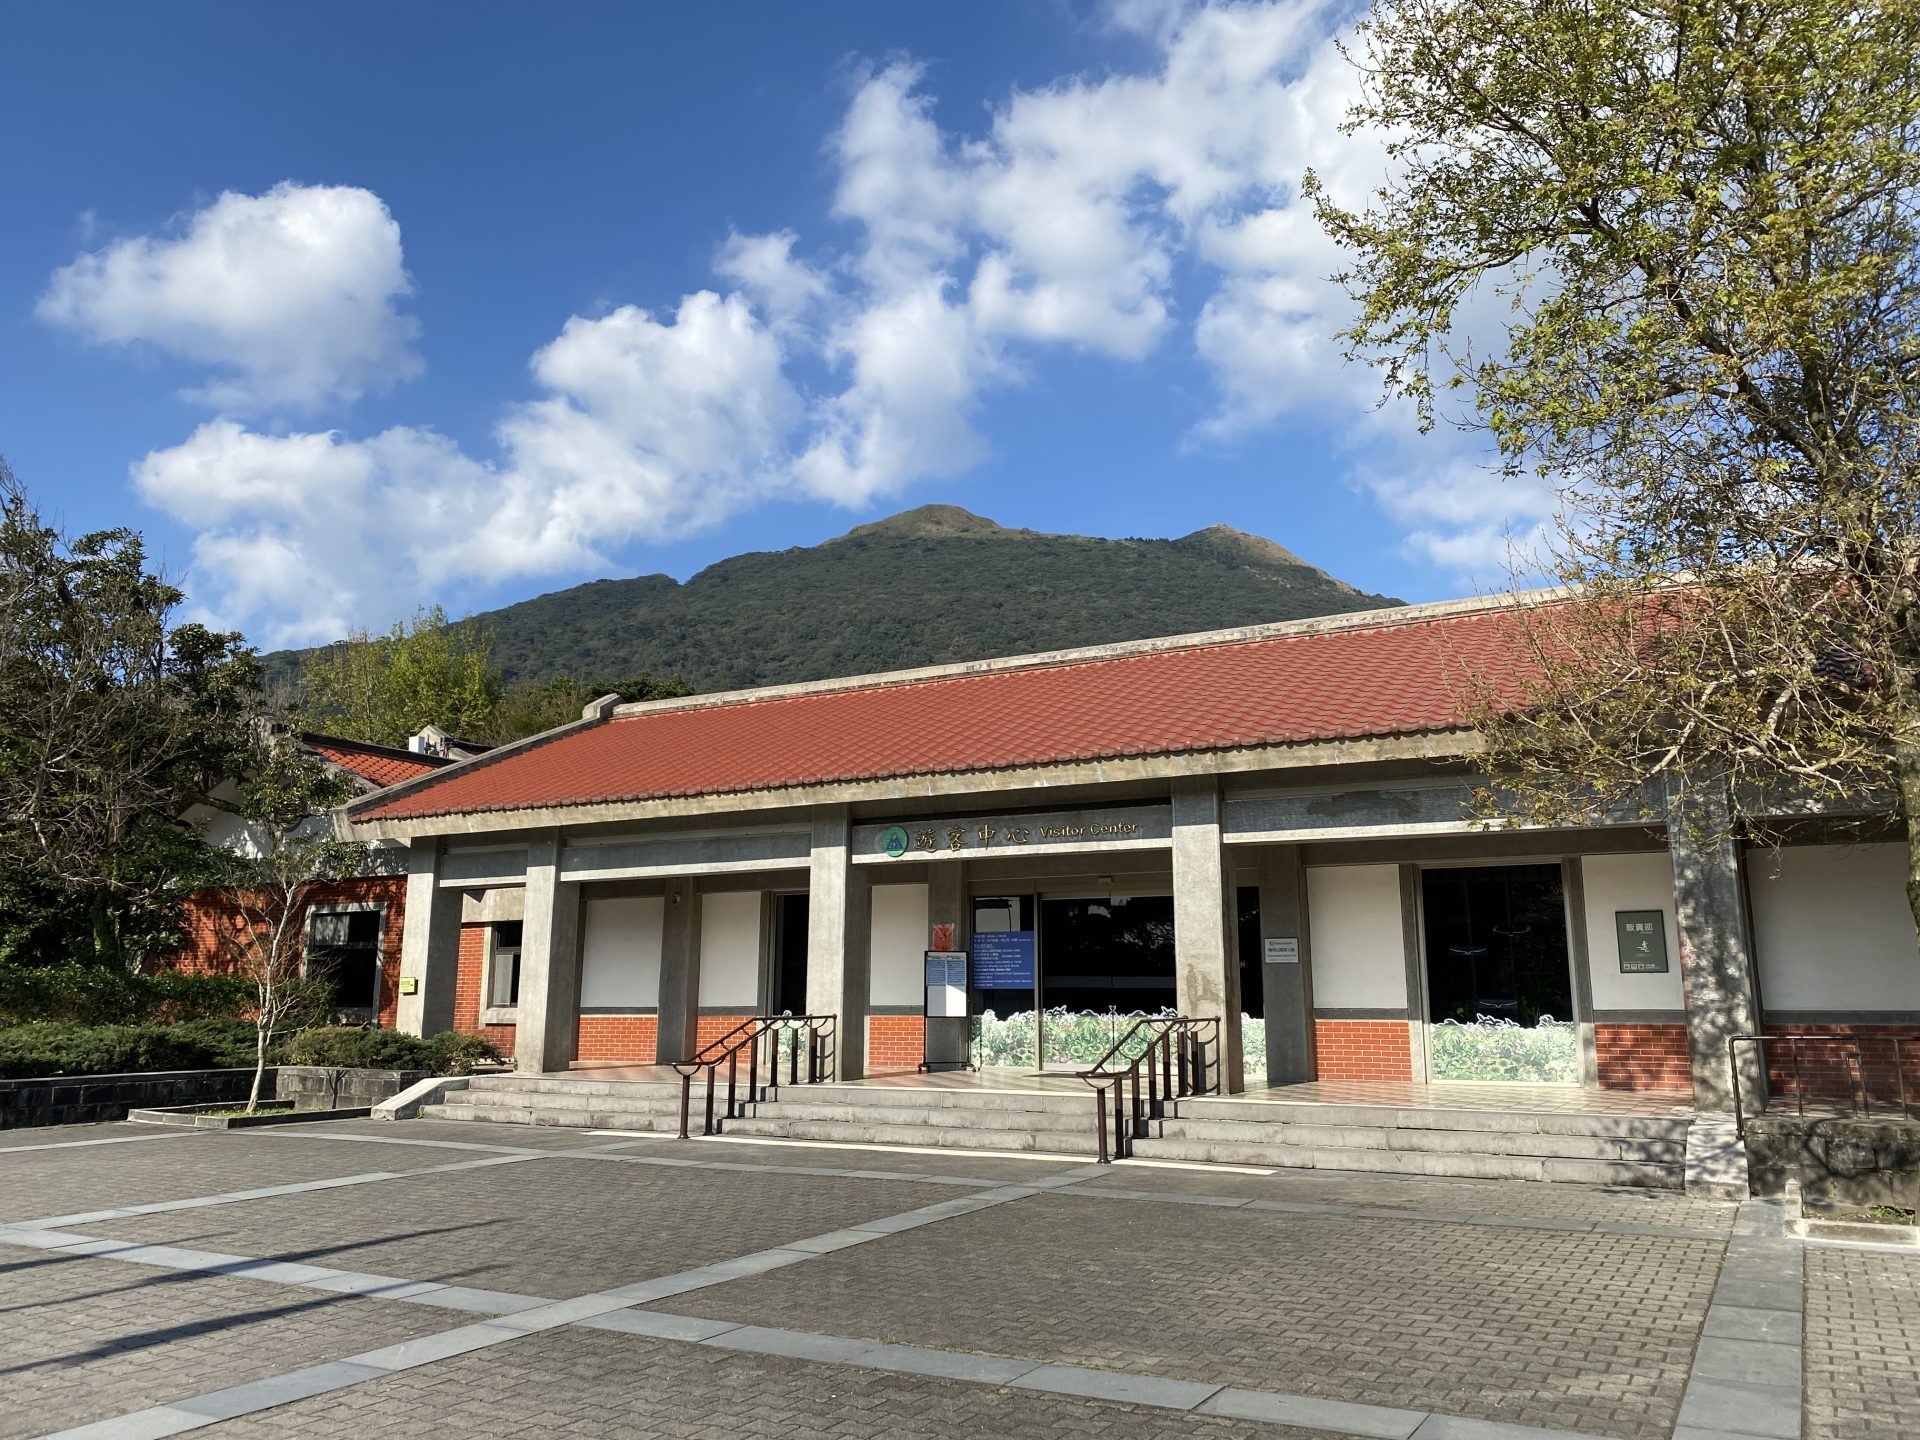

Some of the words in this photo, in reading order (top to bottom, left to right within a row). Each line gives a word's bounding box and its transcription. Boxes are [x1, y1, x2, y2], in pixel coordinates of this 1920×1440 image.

[916, 824, 1030, 853] 遊客中心
[1040, 825, 1086, 837] Visitor
[1090, 822, 1138, 834] Center
